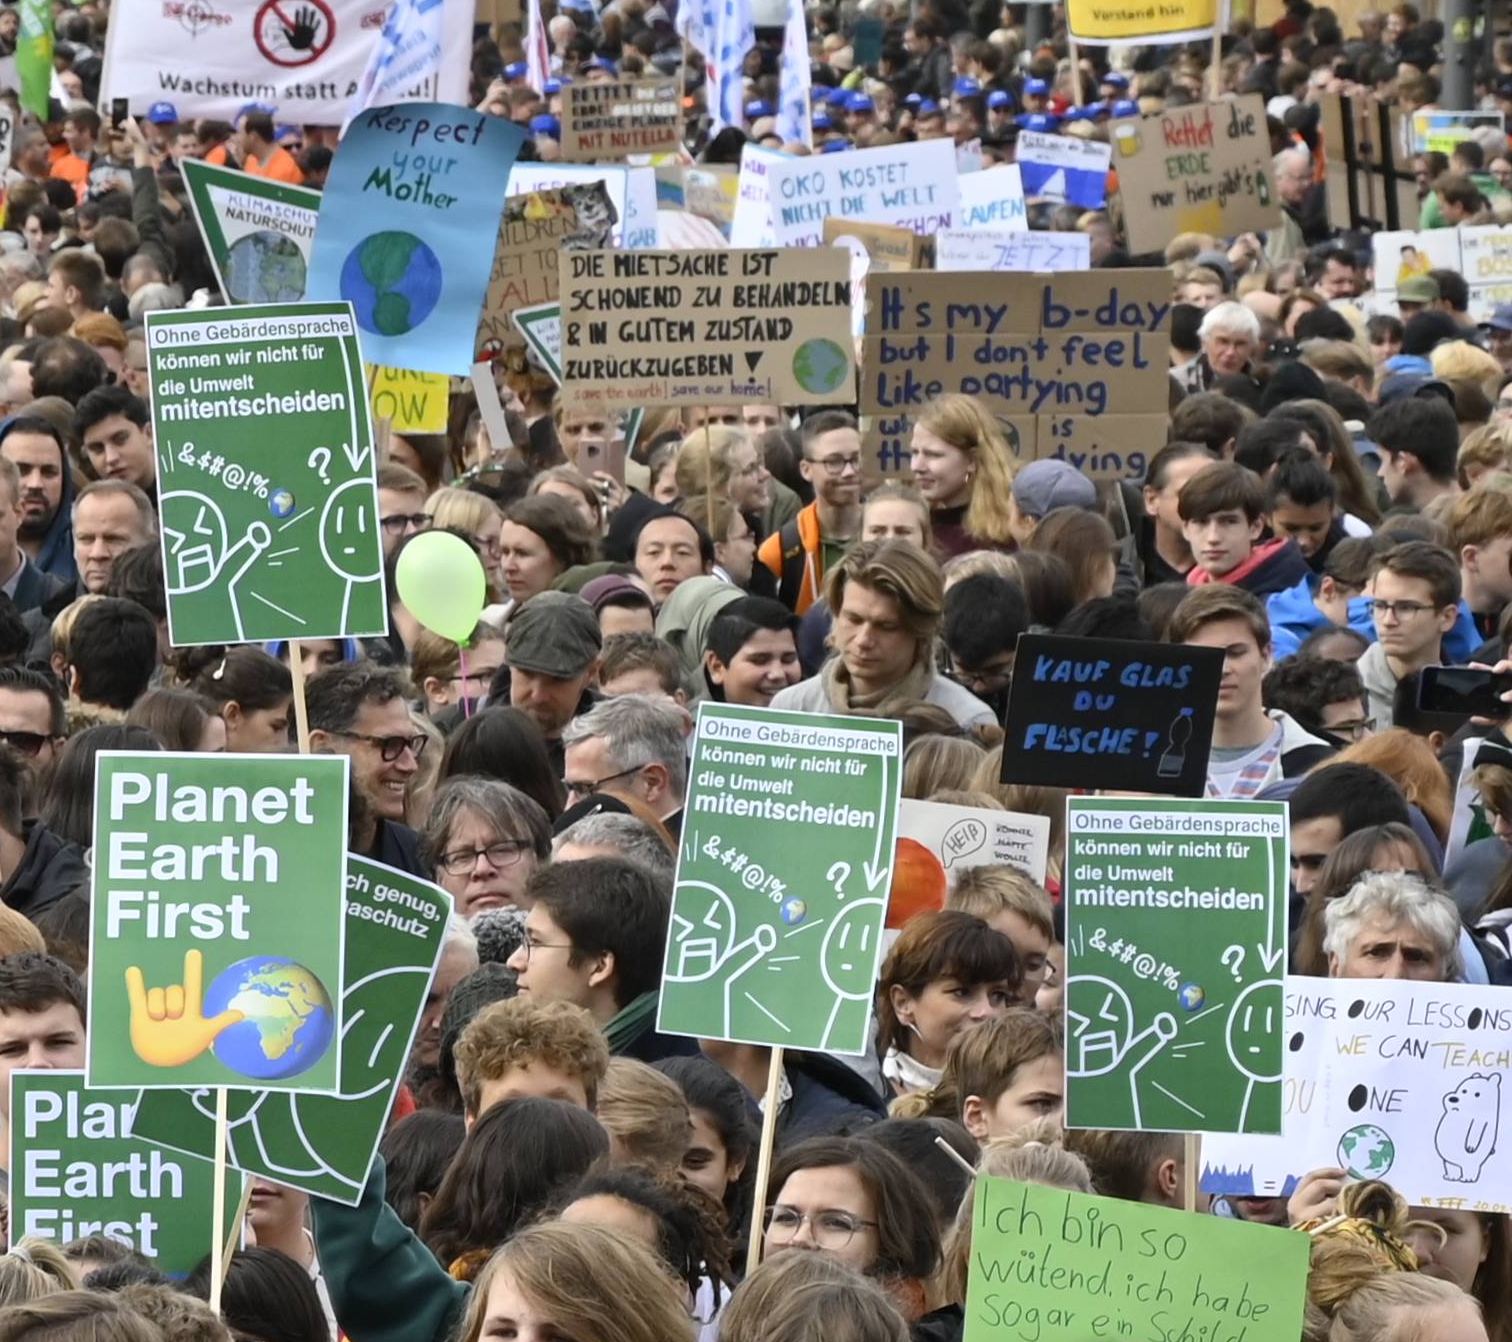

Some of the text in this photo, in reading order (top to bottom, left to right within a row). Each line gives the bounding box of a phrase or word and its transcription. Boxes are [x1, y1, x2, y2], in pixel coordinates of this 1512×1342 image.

[367, 108, 487, 147] Respect
[393, 150, 458, 180] your
[363, 167, 458, 210] Mother
[572, 254, 604, 277] DIE
[613, 253, 730, 276] MIETSACHE
[741, 252, 778, 275] IST
[570, 281, 850, 311] SCHONEND ZU BEHANDELN
[881, 285, 1170, 334] It's my b-day
[567, 317, 794, 347] & IN GUTEM ZUSTAND
[880, 331, 1148, 369] but I don't feel
[565, 351, 734, 382] ZURÜCKZUGEBEN
[671, 383, 700, 397] save
[703, 383, 726, 397] our
[877, 364, 1107, 415] Like partying
[1032, 655, 1193, 690] KAUF GLAS
[1073, 689, 1117, 712] DU
[110, 772, 315, 825] Planet
[1075, 813, 1281, 837] Ohne Gebärdensprache
[108, 832, 279, 883] Earth
[1074, 838, 1251, 859] können wir nicht für
[1074, 864, 1173, 882] die Umwelt
[1074, 886, 1265, 911] mitentscheiden
[106, 890, 251, 940] First
[1348, 999, 1396, 1022] OUR
[1336, 1035, 1512, 1069] WE CAN TEACH
[1348, 1084, 1409, 1112] ONE
[983, 1182, 1187, 1260] Ich bin so
[1126, 1271, 1173, 1303] ich
[1193, 1274, 1269, 1322] habe
[1092, 1309, 1133, 1337] ein
